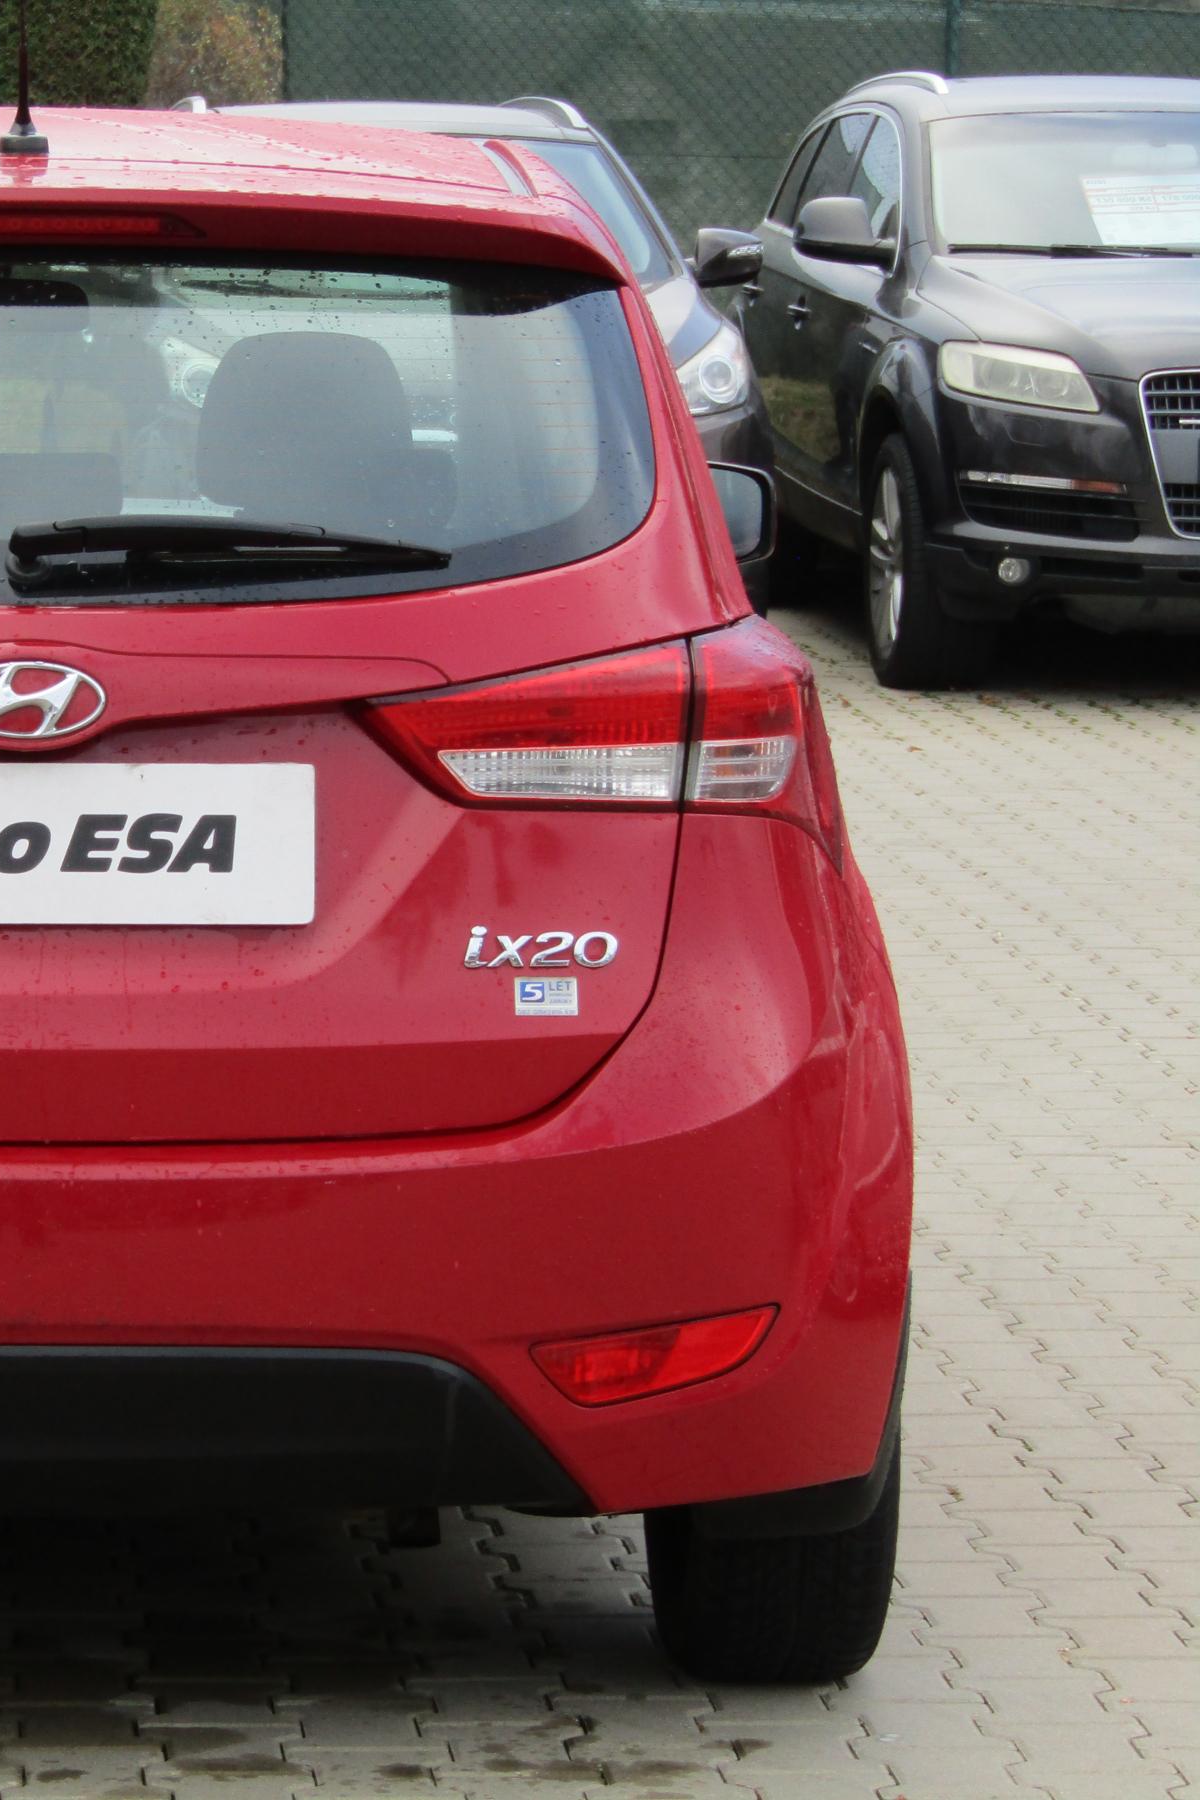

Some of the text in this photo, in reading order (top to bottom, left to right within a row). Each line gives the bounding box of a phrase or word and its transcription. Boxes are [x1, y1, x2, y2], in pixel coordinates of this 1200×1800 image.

[60, 812, 237, 874] ESA
[463, 925, 618, 969] ix20
[522, 980, 573, 1001] 5 LET
